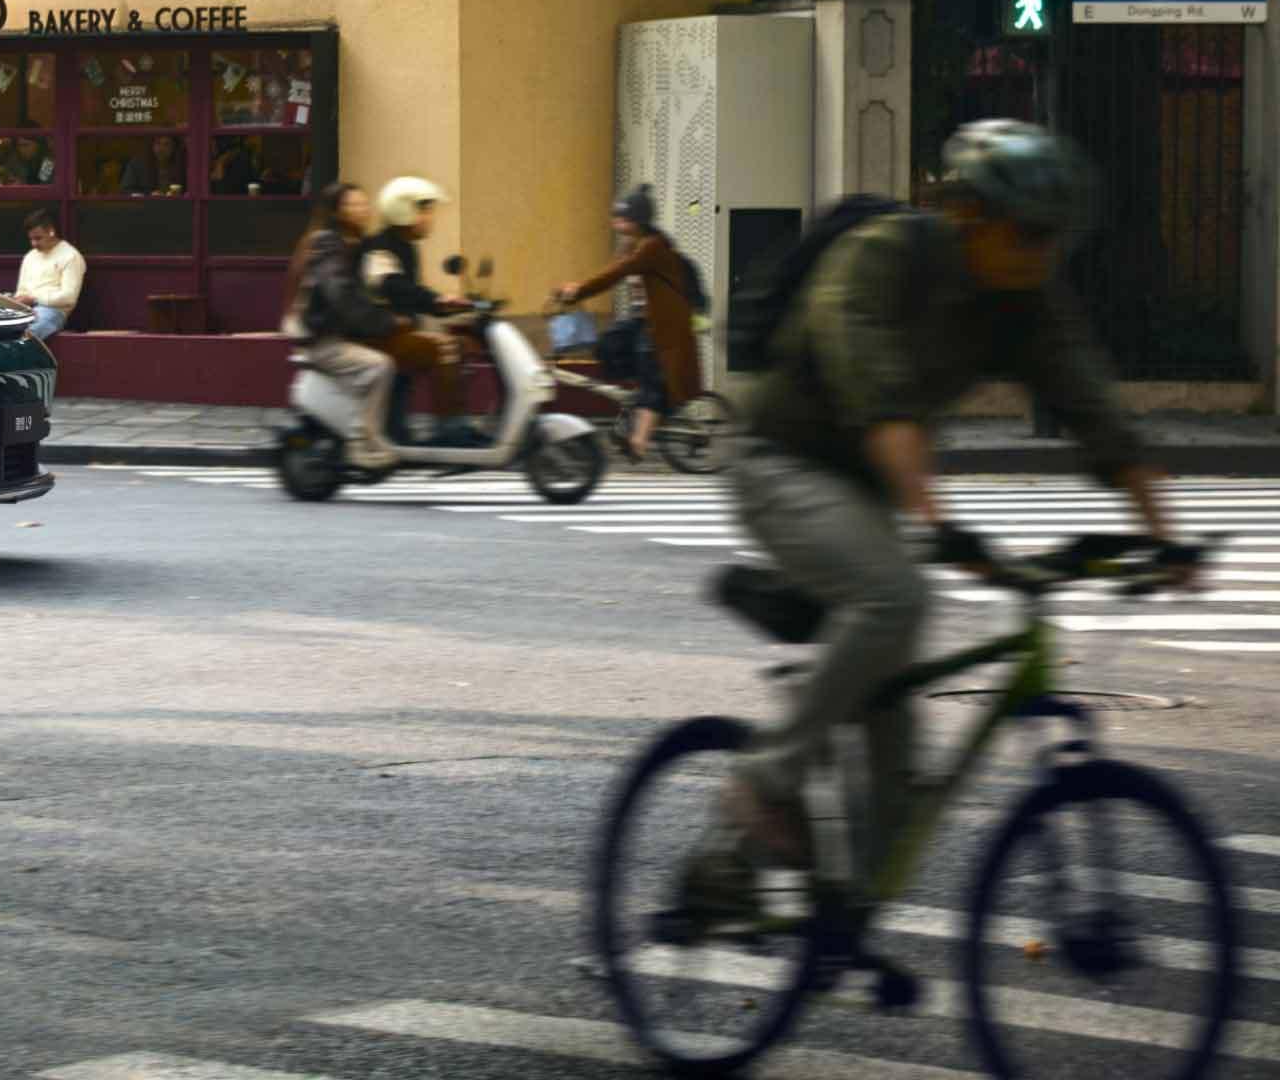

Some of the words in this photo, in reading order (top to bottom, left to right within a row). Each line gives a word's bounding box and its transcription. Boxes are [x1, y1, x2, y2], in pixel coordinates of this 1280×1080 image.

[1084, 5, 1096, 19] E
[1128, 5, 1182, 18] Dongping
[1241, 5, 1256, 19] W
[28, 8, 116, 34] BAKERY
[127, 10, 143, 33] &
[155, 6, 247, 32] COFFEE
[119, 86, 146, 96] MERRY
[110, 96, 159, 108] CHRISTMAS
